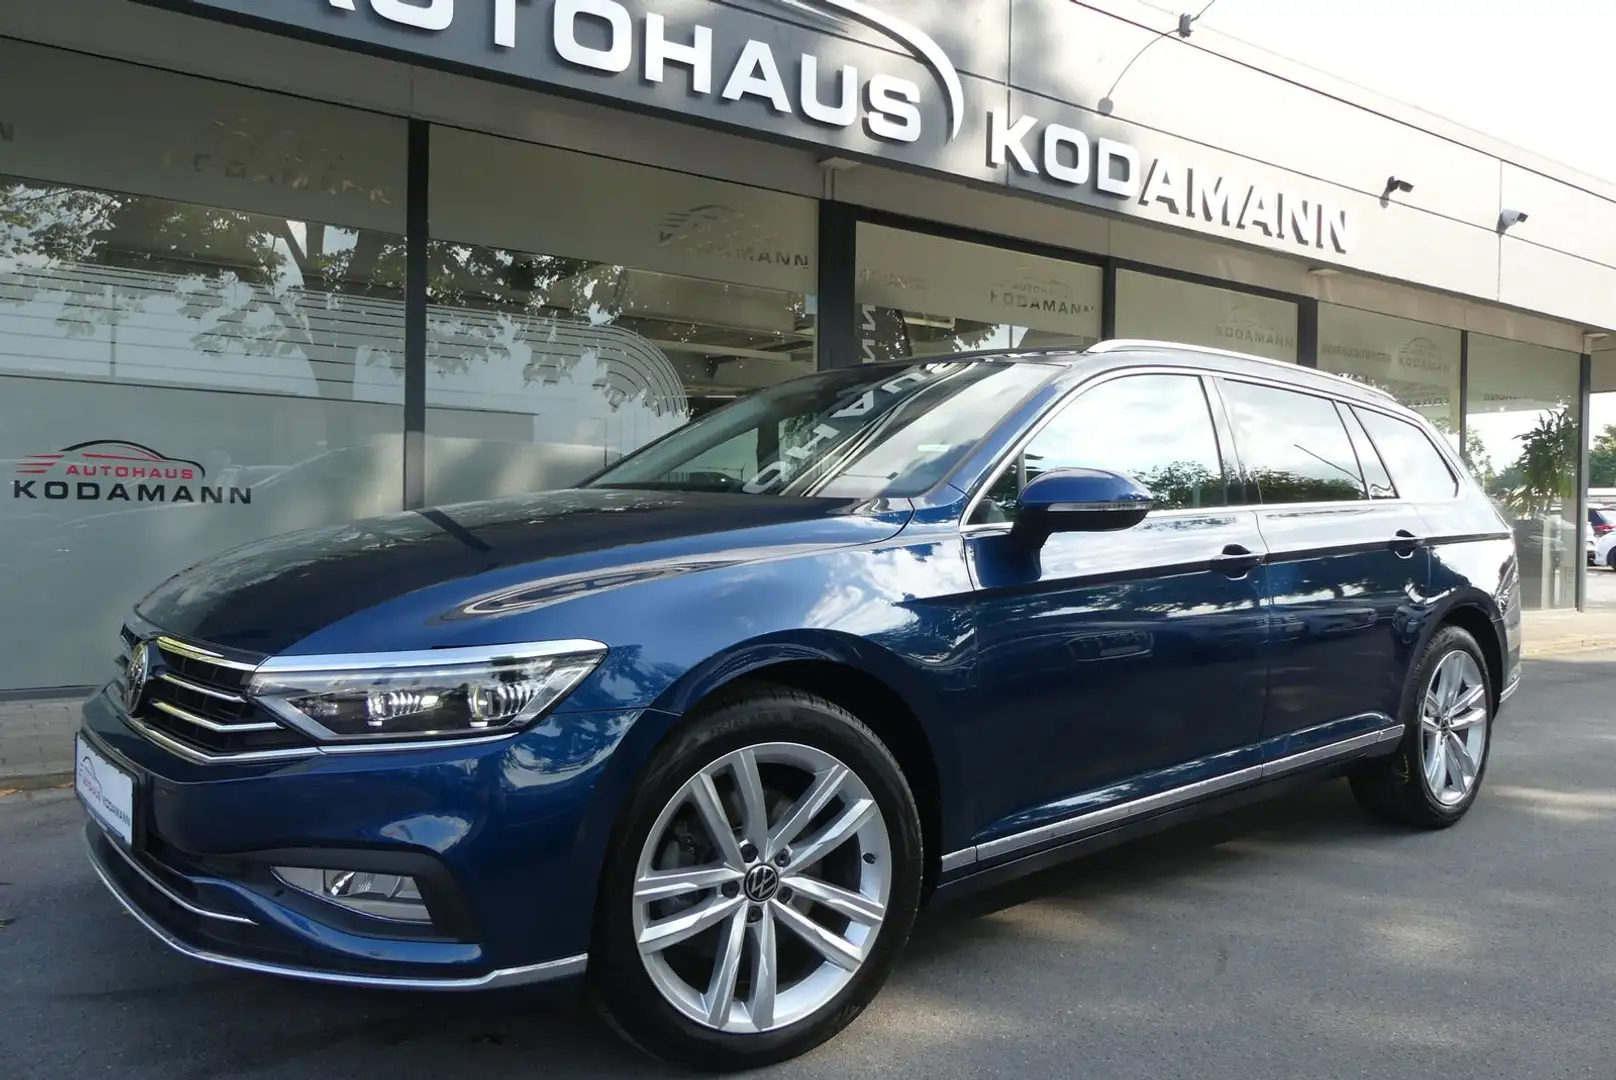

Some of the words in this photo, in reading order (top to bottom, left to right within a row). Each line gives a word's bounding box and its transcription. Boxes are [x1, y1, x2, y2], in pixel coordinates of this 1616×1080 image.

[329, 0, 922, 142] TOHAUS
[987, 107, 1353, 255] KODAMANN
[13, 479, 253, 505] KODAMANN
[65, 463, 195, 481] AUTOHAUS
